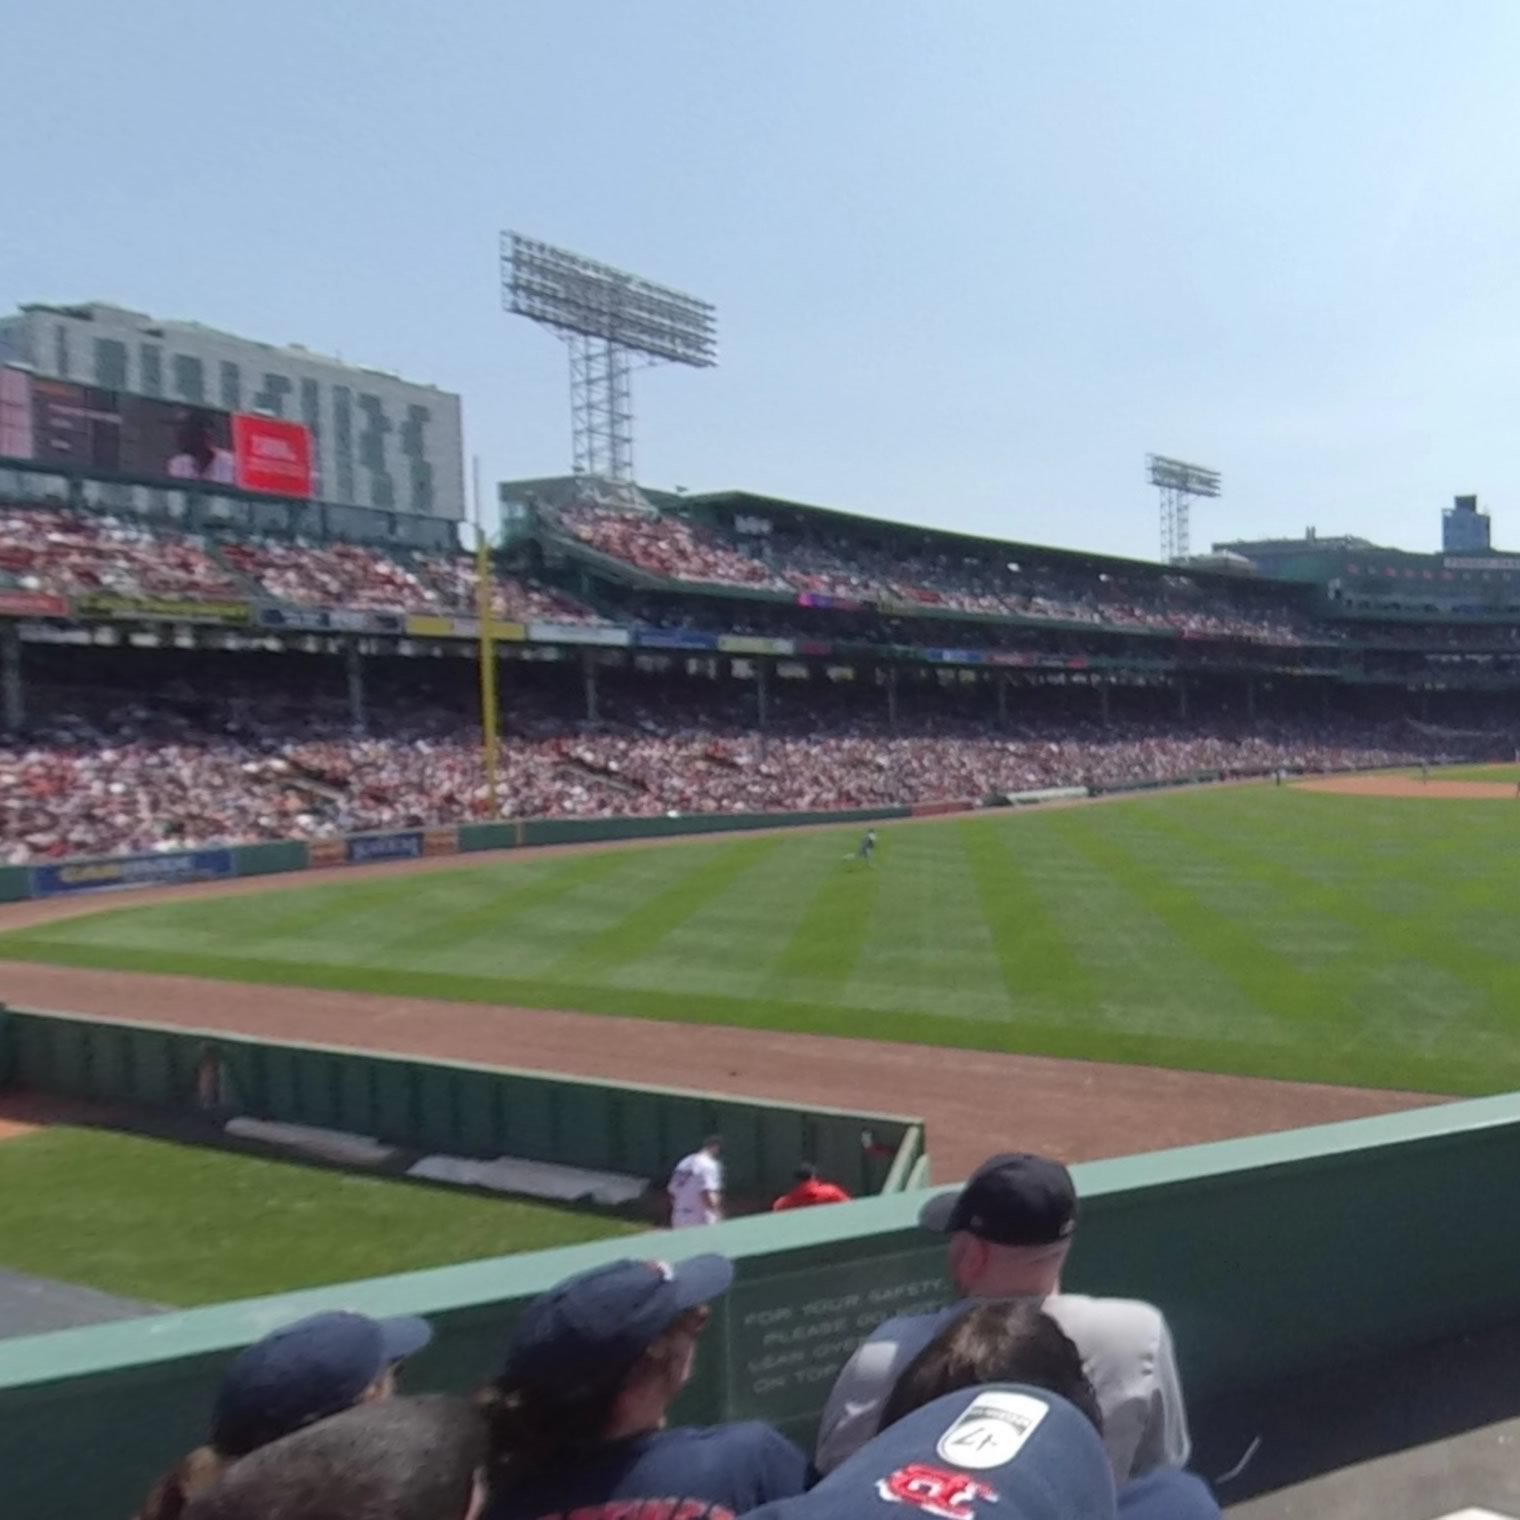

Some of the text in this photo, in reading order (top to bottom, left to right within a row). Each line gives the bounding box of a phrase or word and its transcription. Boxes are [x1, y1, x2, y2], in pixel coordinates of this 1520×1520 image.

[744, 1306, 792, 1325] FOR
[801, 1294, 860, 1316] YOUR
[763, 1318, 847, 1346] PLEASE
[748, 1350, 805, 1371] LEAN
[753, 1376, 786, 1394] ON
